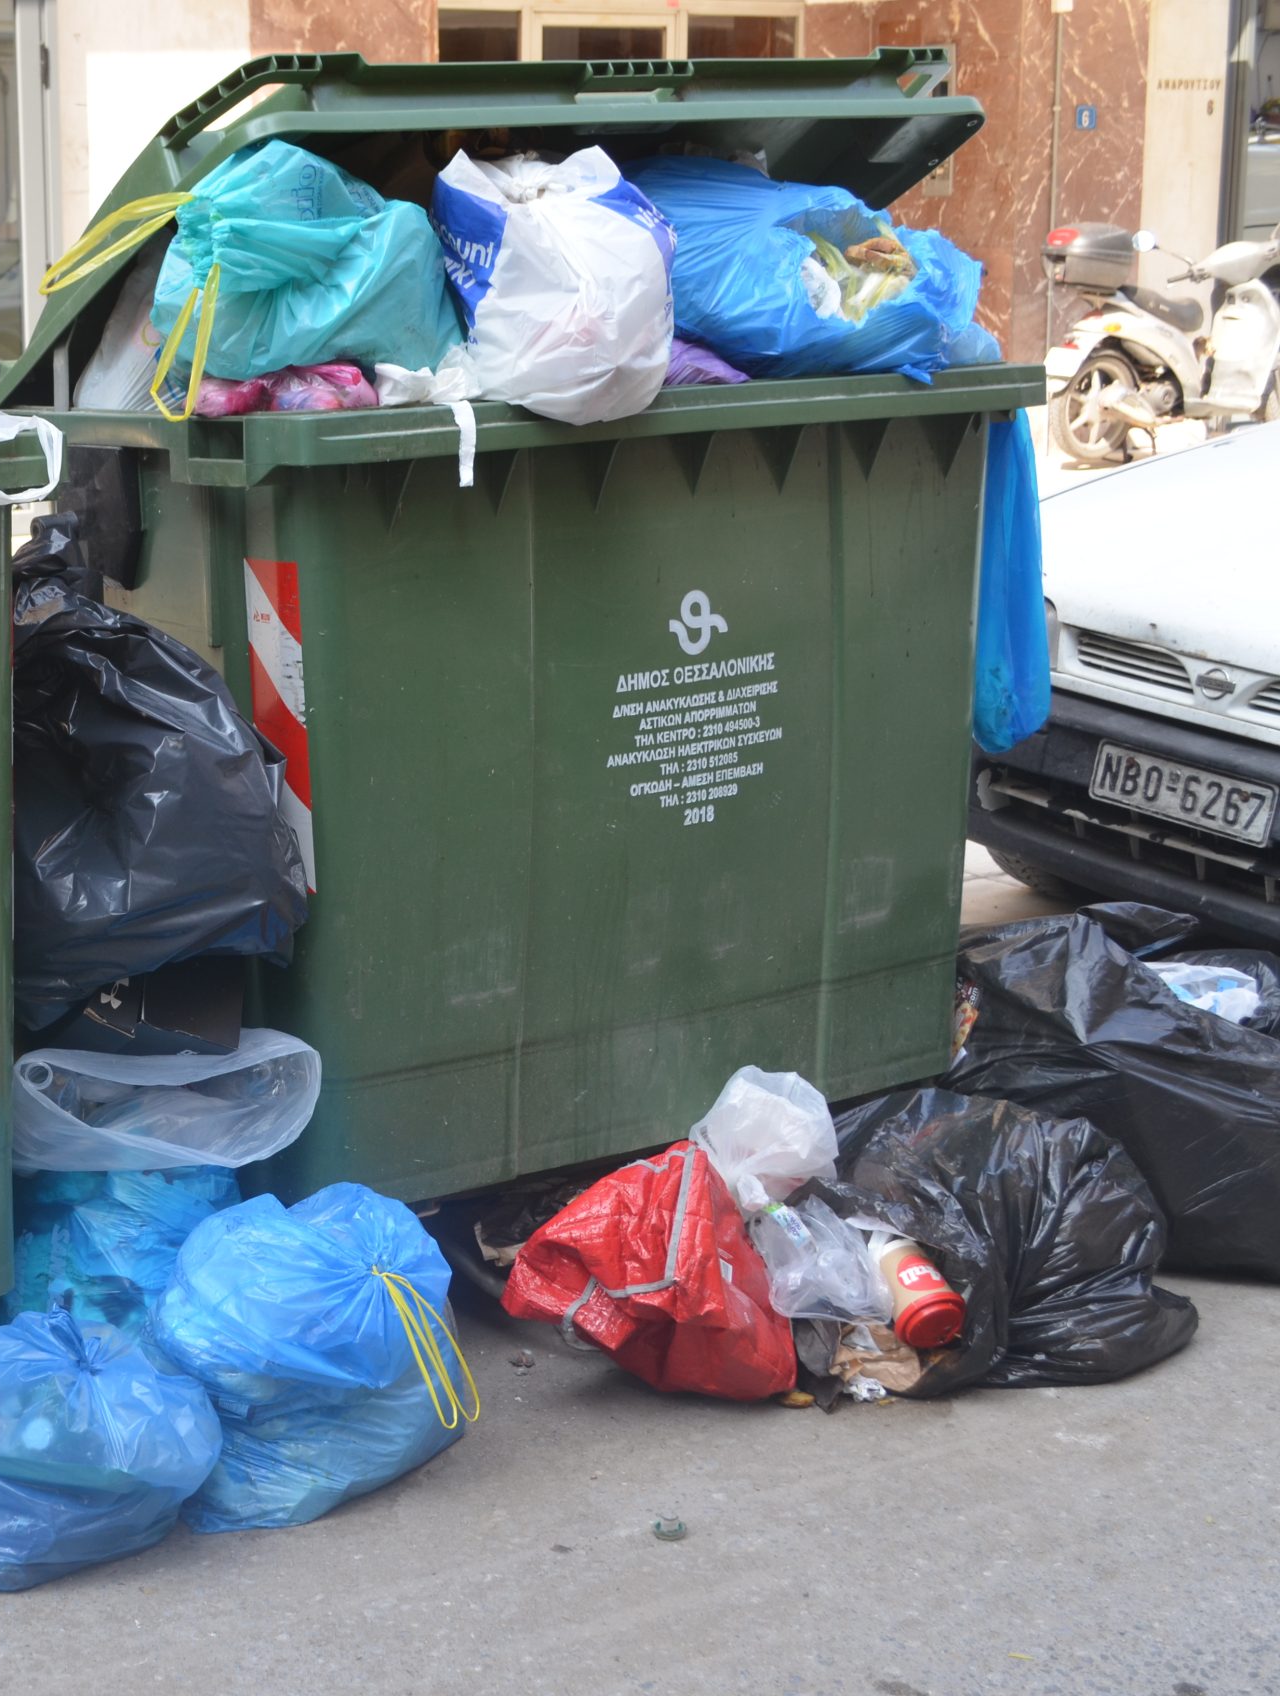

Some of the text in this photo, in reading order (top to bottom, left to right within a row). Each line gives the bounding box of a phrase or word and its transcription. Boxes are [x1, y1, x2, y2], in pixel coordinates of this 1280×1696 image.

[1082, 110, 1089, 127] 6
[616, 669, 670, 693] ΔΗΜΟΣ
[645, 690, 716, 714] ΑΝΑΚΥΚΛΩΣΗΣ
[726, 680, 778, 700] ΔΙΑΧΕΙΡΙΣΗΣ
[639, 701, 757, 731] ΑΣΤΙΚΩΝ ΑΠΟΡΡΙΜΜΑΤΩΝ
[634, 733, 655, 747] ΤΗΛ
[656, 725, 696, 744] ΚΕΝΤΡΟ
[703, 721, 723, 736] 2310
[724, 716, 760, 732] 494500-3
[607, 727, 782, 768] ΑΝΑΚΥΚΛΩΣΗ ΗΛΕΚΤΡΙΚΩΝ ΣΥΣΚΕΥΩΝ
[660, 762, 680, 776] ΤΗΛ
[686, 757, 708, 772] 2310
[709, 752, 738, 768] 512085
[630, 777, 672, 797] ΟΓΚΩΔΗ
[681, 770, 714, 789] ΑΜΕΣΗ
[715, 762, 764, 783] ΕΠΕΜΒΑΣΗ
[659, 793, 680, 808] ΤΗΛ
[685, 789, 707, 804] 2310
[708, 784, 738, 800] 208929
[683, 804, 715, 826] 2018
